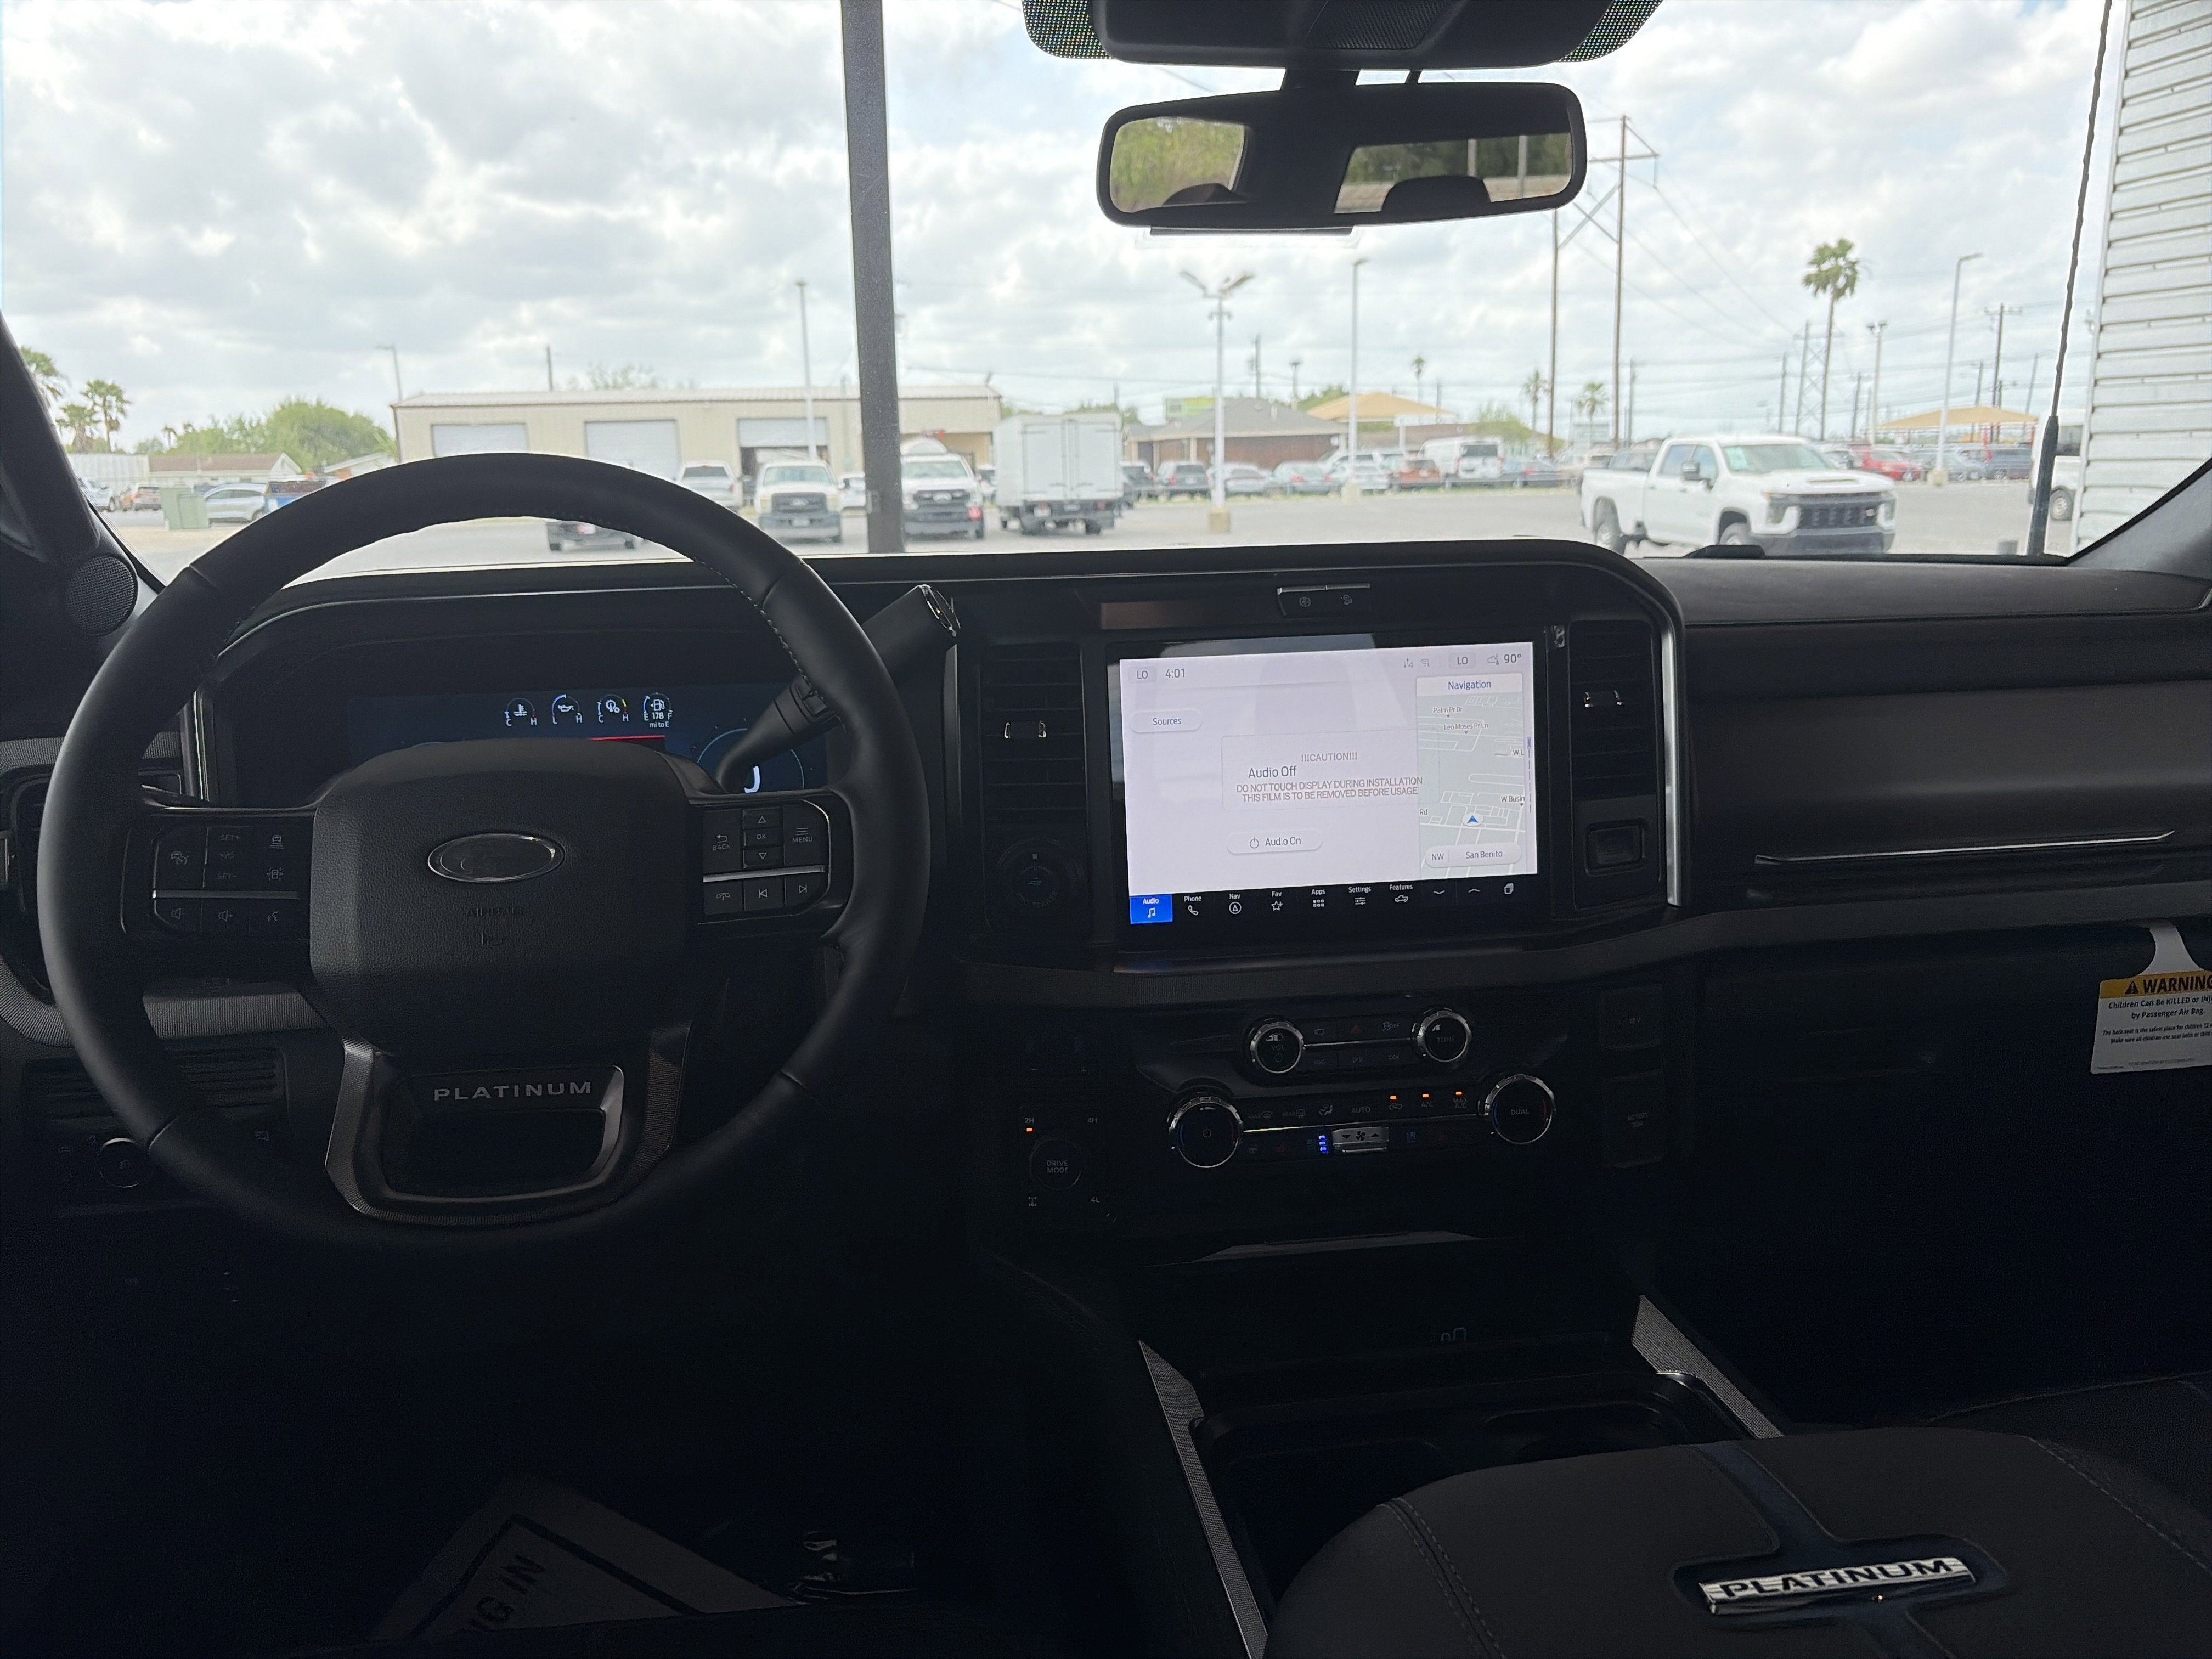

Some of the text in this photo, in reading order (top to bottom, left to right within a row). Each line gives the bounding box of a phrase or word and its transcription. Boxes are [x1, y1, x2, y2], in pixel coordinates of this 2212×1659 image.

[1457, 657, 1468, 665] LO
[1137, 670, 1148, 679] LO
[1165, 668, 1185, 679] 4:01
[1448, 680, 1492, 691] Navigation
[576, 714, 582, 723] H
[598, 714, 603, 723] C
[623, 714, 629, 722] H
[1153, 717, 1182, 726] Sources
[1248, 765, 1297, 778] Audio Off
[1237, 777, 1423, 793] DO NOT TOUCH DISPLAY DURING INSTALLATION
[1242, 787, 1418, 802] THIS FILM IS TO BE REMOVED BEFORE USAGE
[1265, 836, 1301, 847] Audio On
[1480, 850, 1503, 859] Benito
[2109, 1000, 2138, 1008] Children
[2142, 1010, 2177, 1019] Passenger
[435, 1081, 591, 1101] PLATINUM
[1719, 1559, 1952, 1597] PLATINUM
